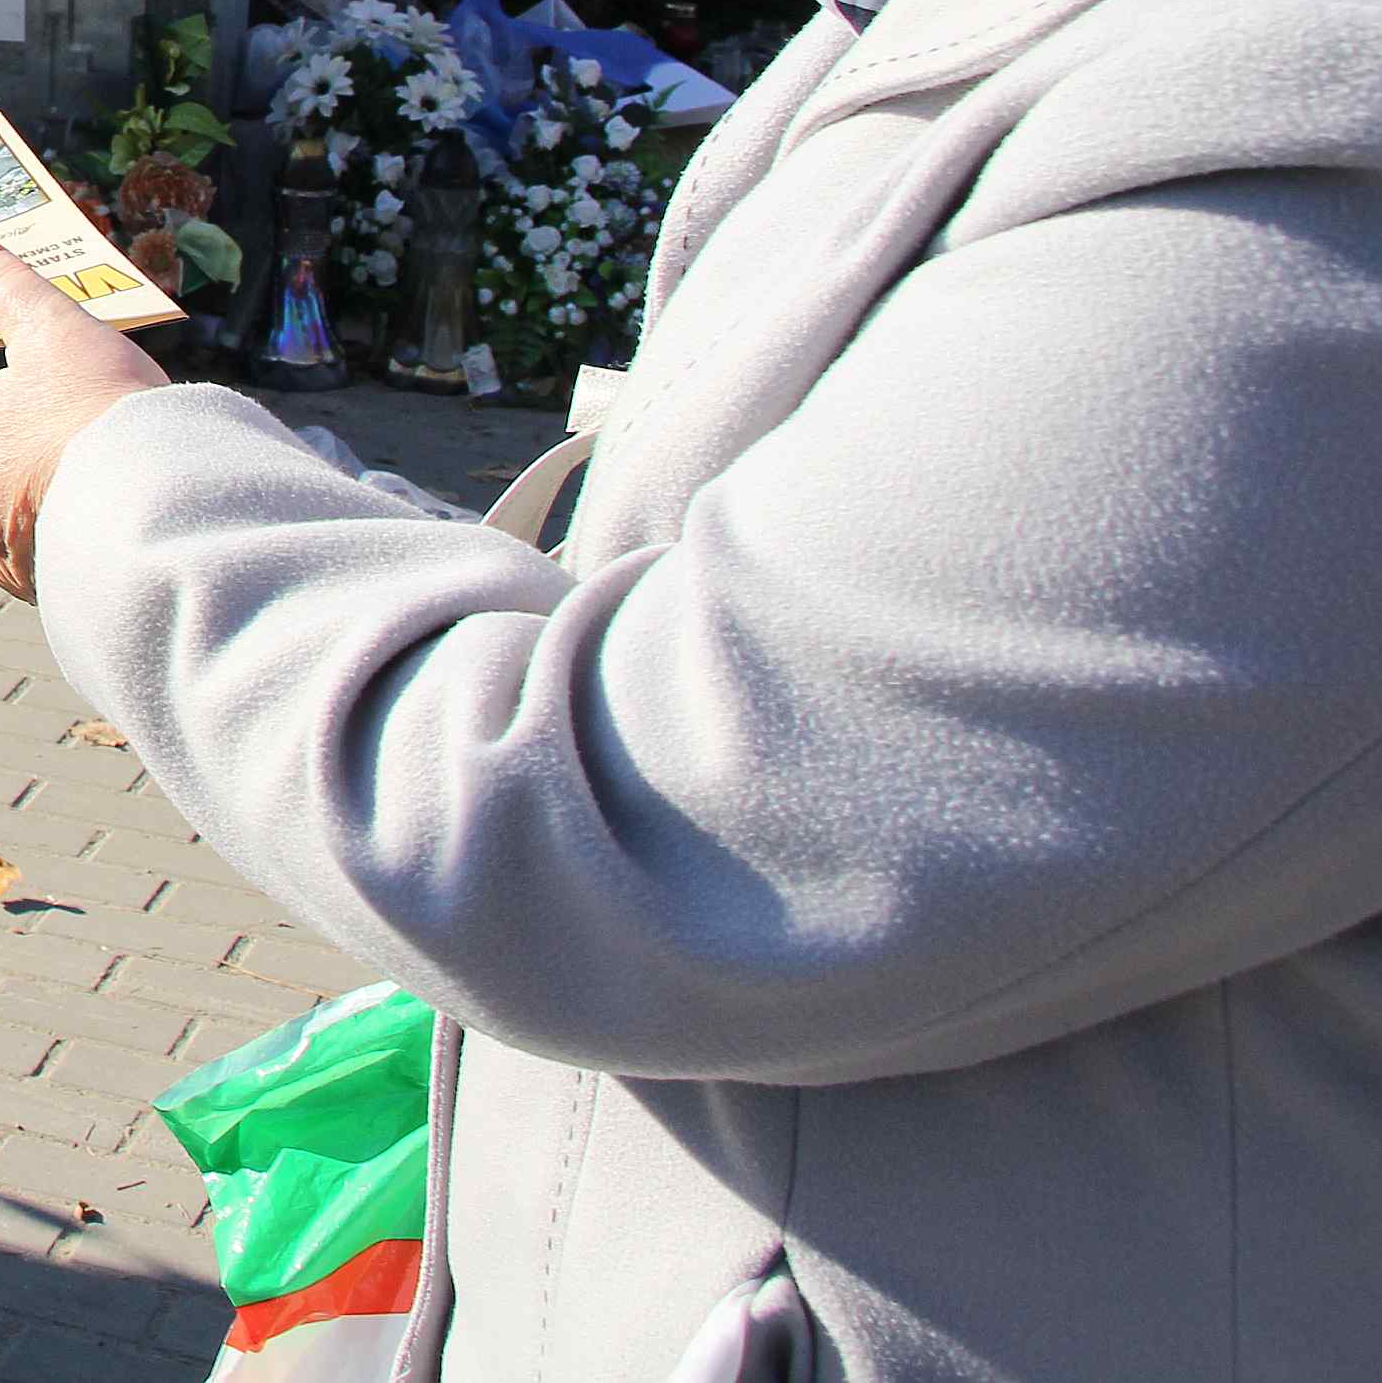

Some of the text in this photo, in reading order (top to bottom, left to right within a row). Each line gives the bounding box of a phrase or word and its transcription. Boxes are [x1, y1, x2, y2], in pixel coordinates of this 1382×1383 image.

[62, 236, 84, 247] NA
[17, 243, 60, 259] CMEN
[49, 263, 144, 303] VI
